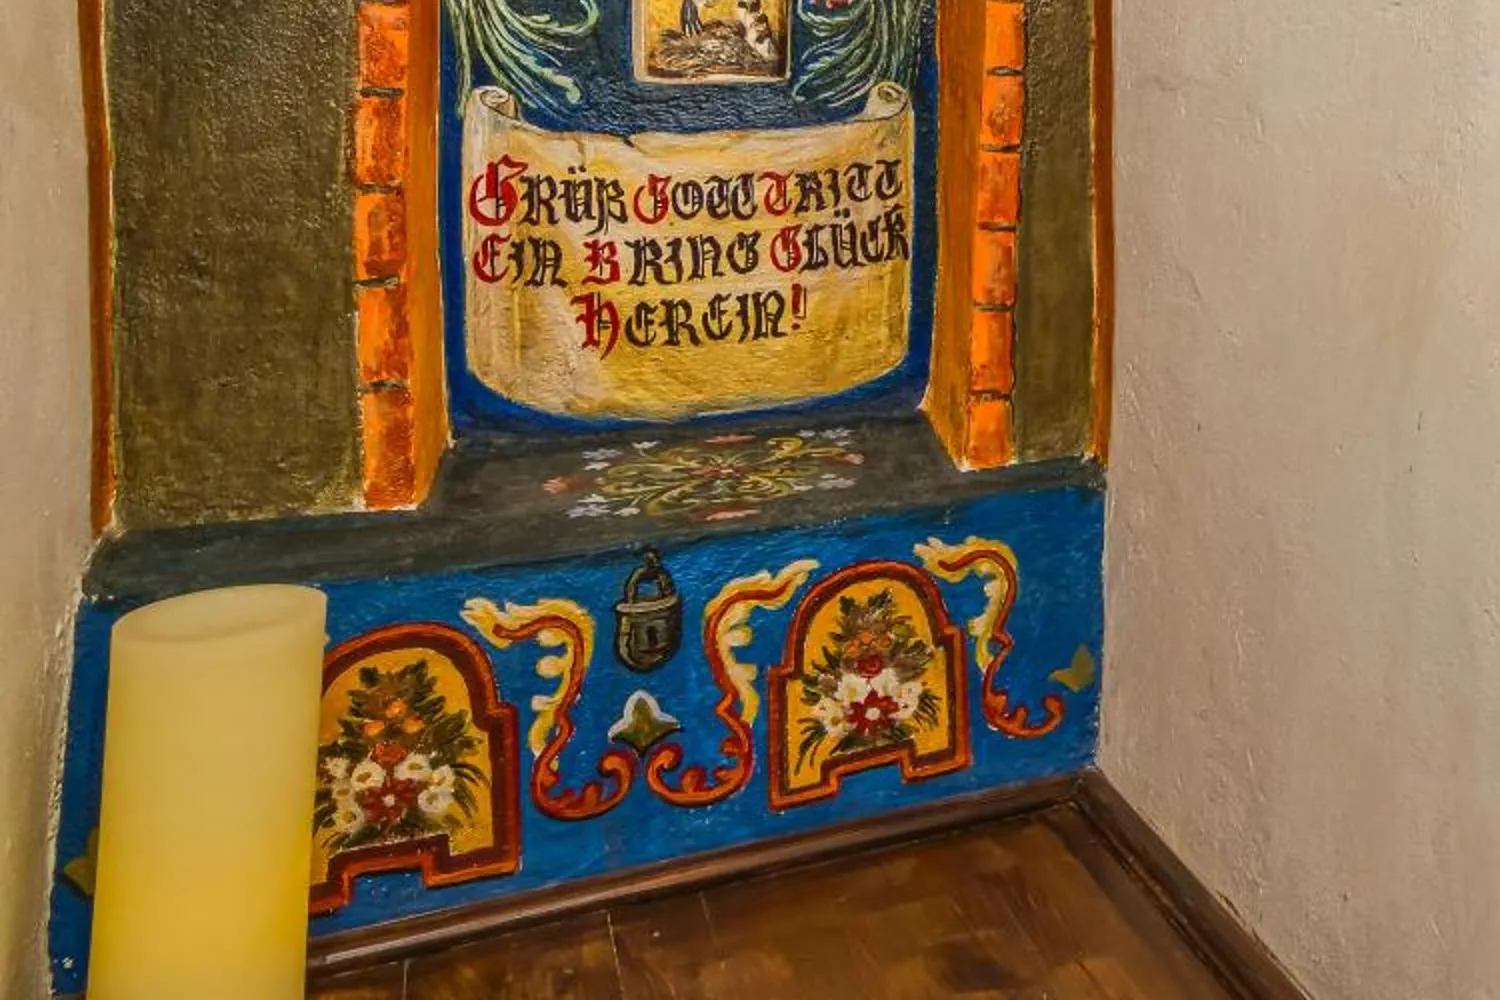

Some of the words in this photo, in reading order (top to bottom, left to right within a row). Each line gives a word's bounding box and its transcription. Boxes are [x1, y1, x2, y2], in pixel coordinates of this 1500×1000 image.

[634, 174, 758, 225] GOTT
[760, 159, 904, 215] TRITT
[472, 234, 568, 287] EIN
[582, 230, 760, 287] BRING
